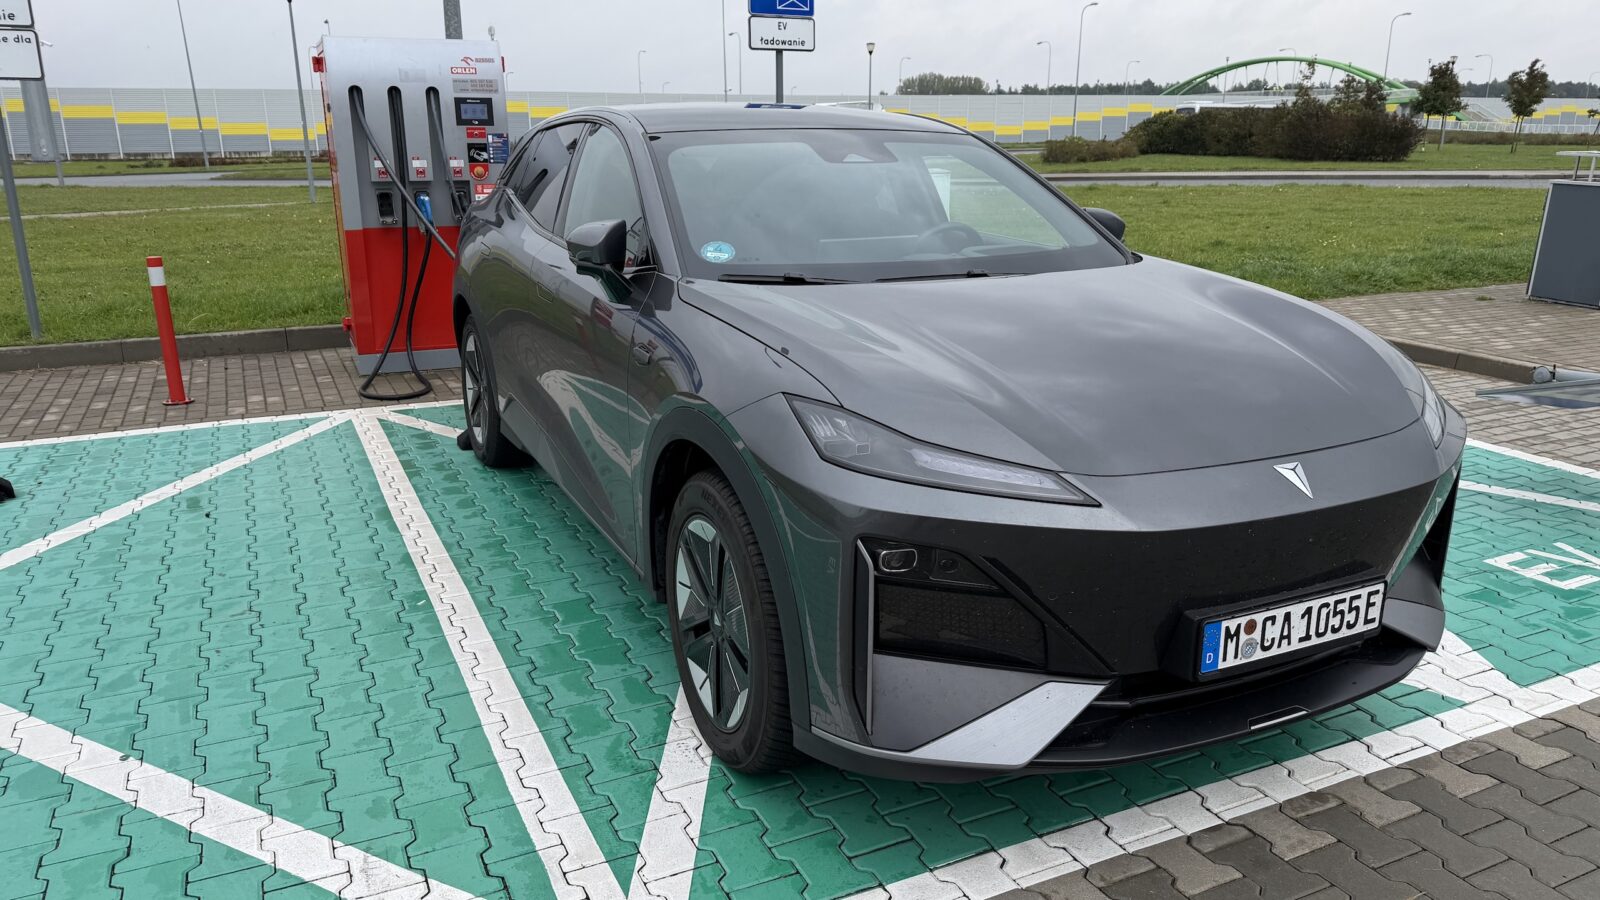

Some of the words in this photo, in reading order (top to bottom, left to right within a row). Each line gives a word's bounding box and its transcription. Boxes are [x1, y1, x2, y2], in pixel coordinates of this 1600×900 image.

[777, 21, 787, 30] EV
[13, 34, 32, 43] dla
[760, 36, 806, 47] ładowanie
[1482, 541, 1600, 590] EV
[1222, 622, 1242, 662] M
[1260, 611, 1292, 652] CA
[1206, 652, 1214, 664] D
